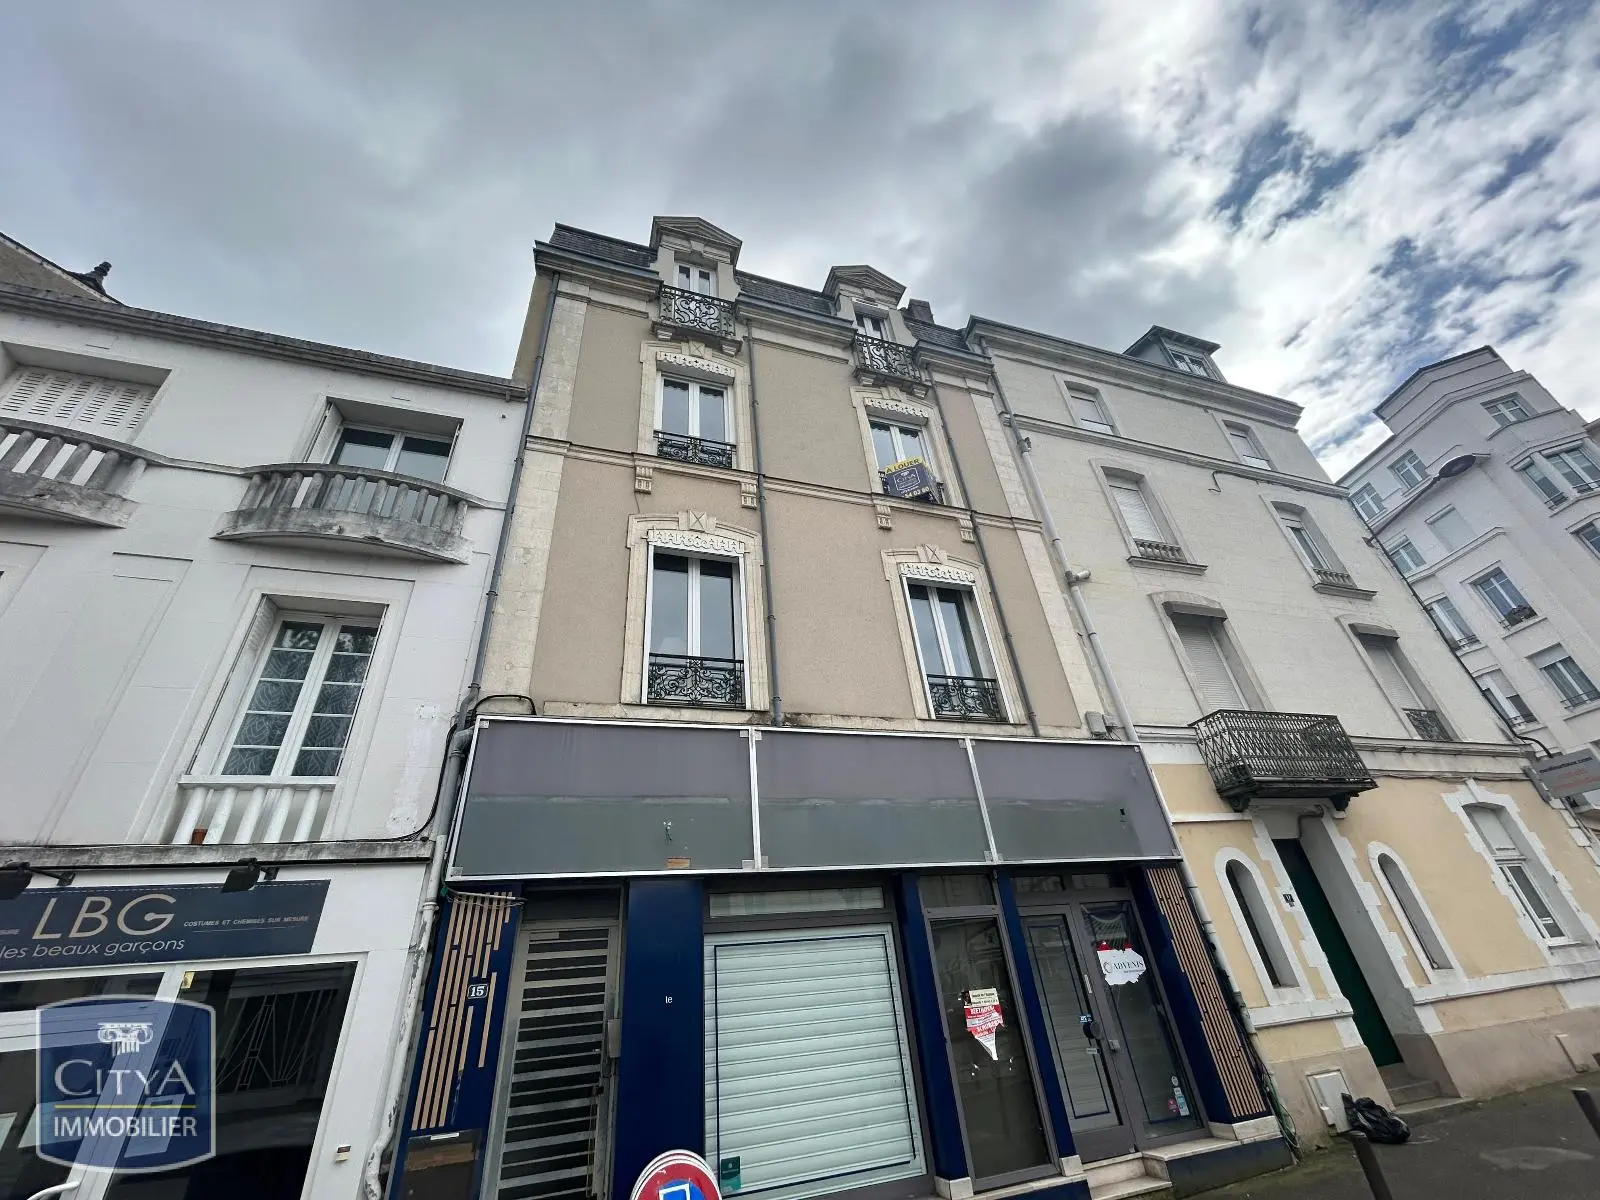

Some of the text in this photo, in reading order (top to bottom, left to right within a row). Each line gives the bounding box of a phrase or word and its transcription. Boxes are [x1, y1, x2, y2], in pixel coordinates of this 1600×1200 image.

[893, 458, 920, 471] LOUER
[32, 893, 178, 940] LBG
[183, 920, 220, 928] COSTUMES
[233, 918, 265, 926] CHEMISES
[0, 938, 185, 959] les beaux garçons
[470, 986, 485, 997] 15
[665, 995, 673, 1004] le
